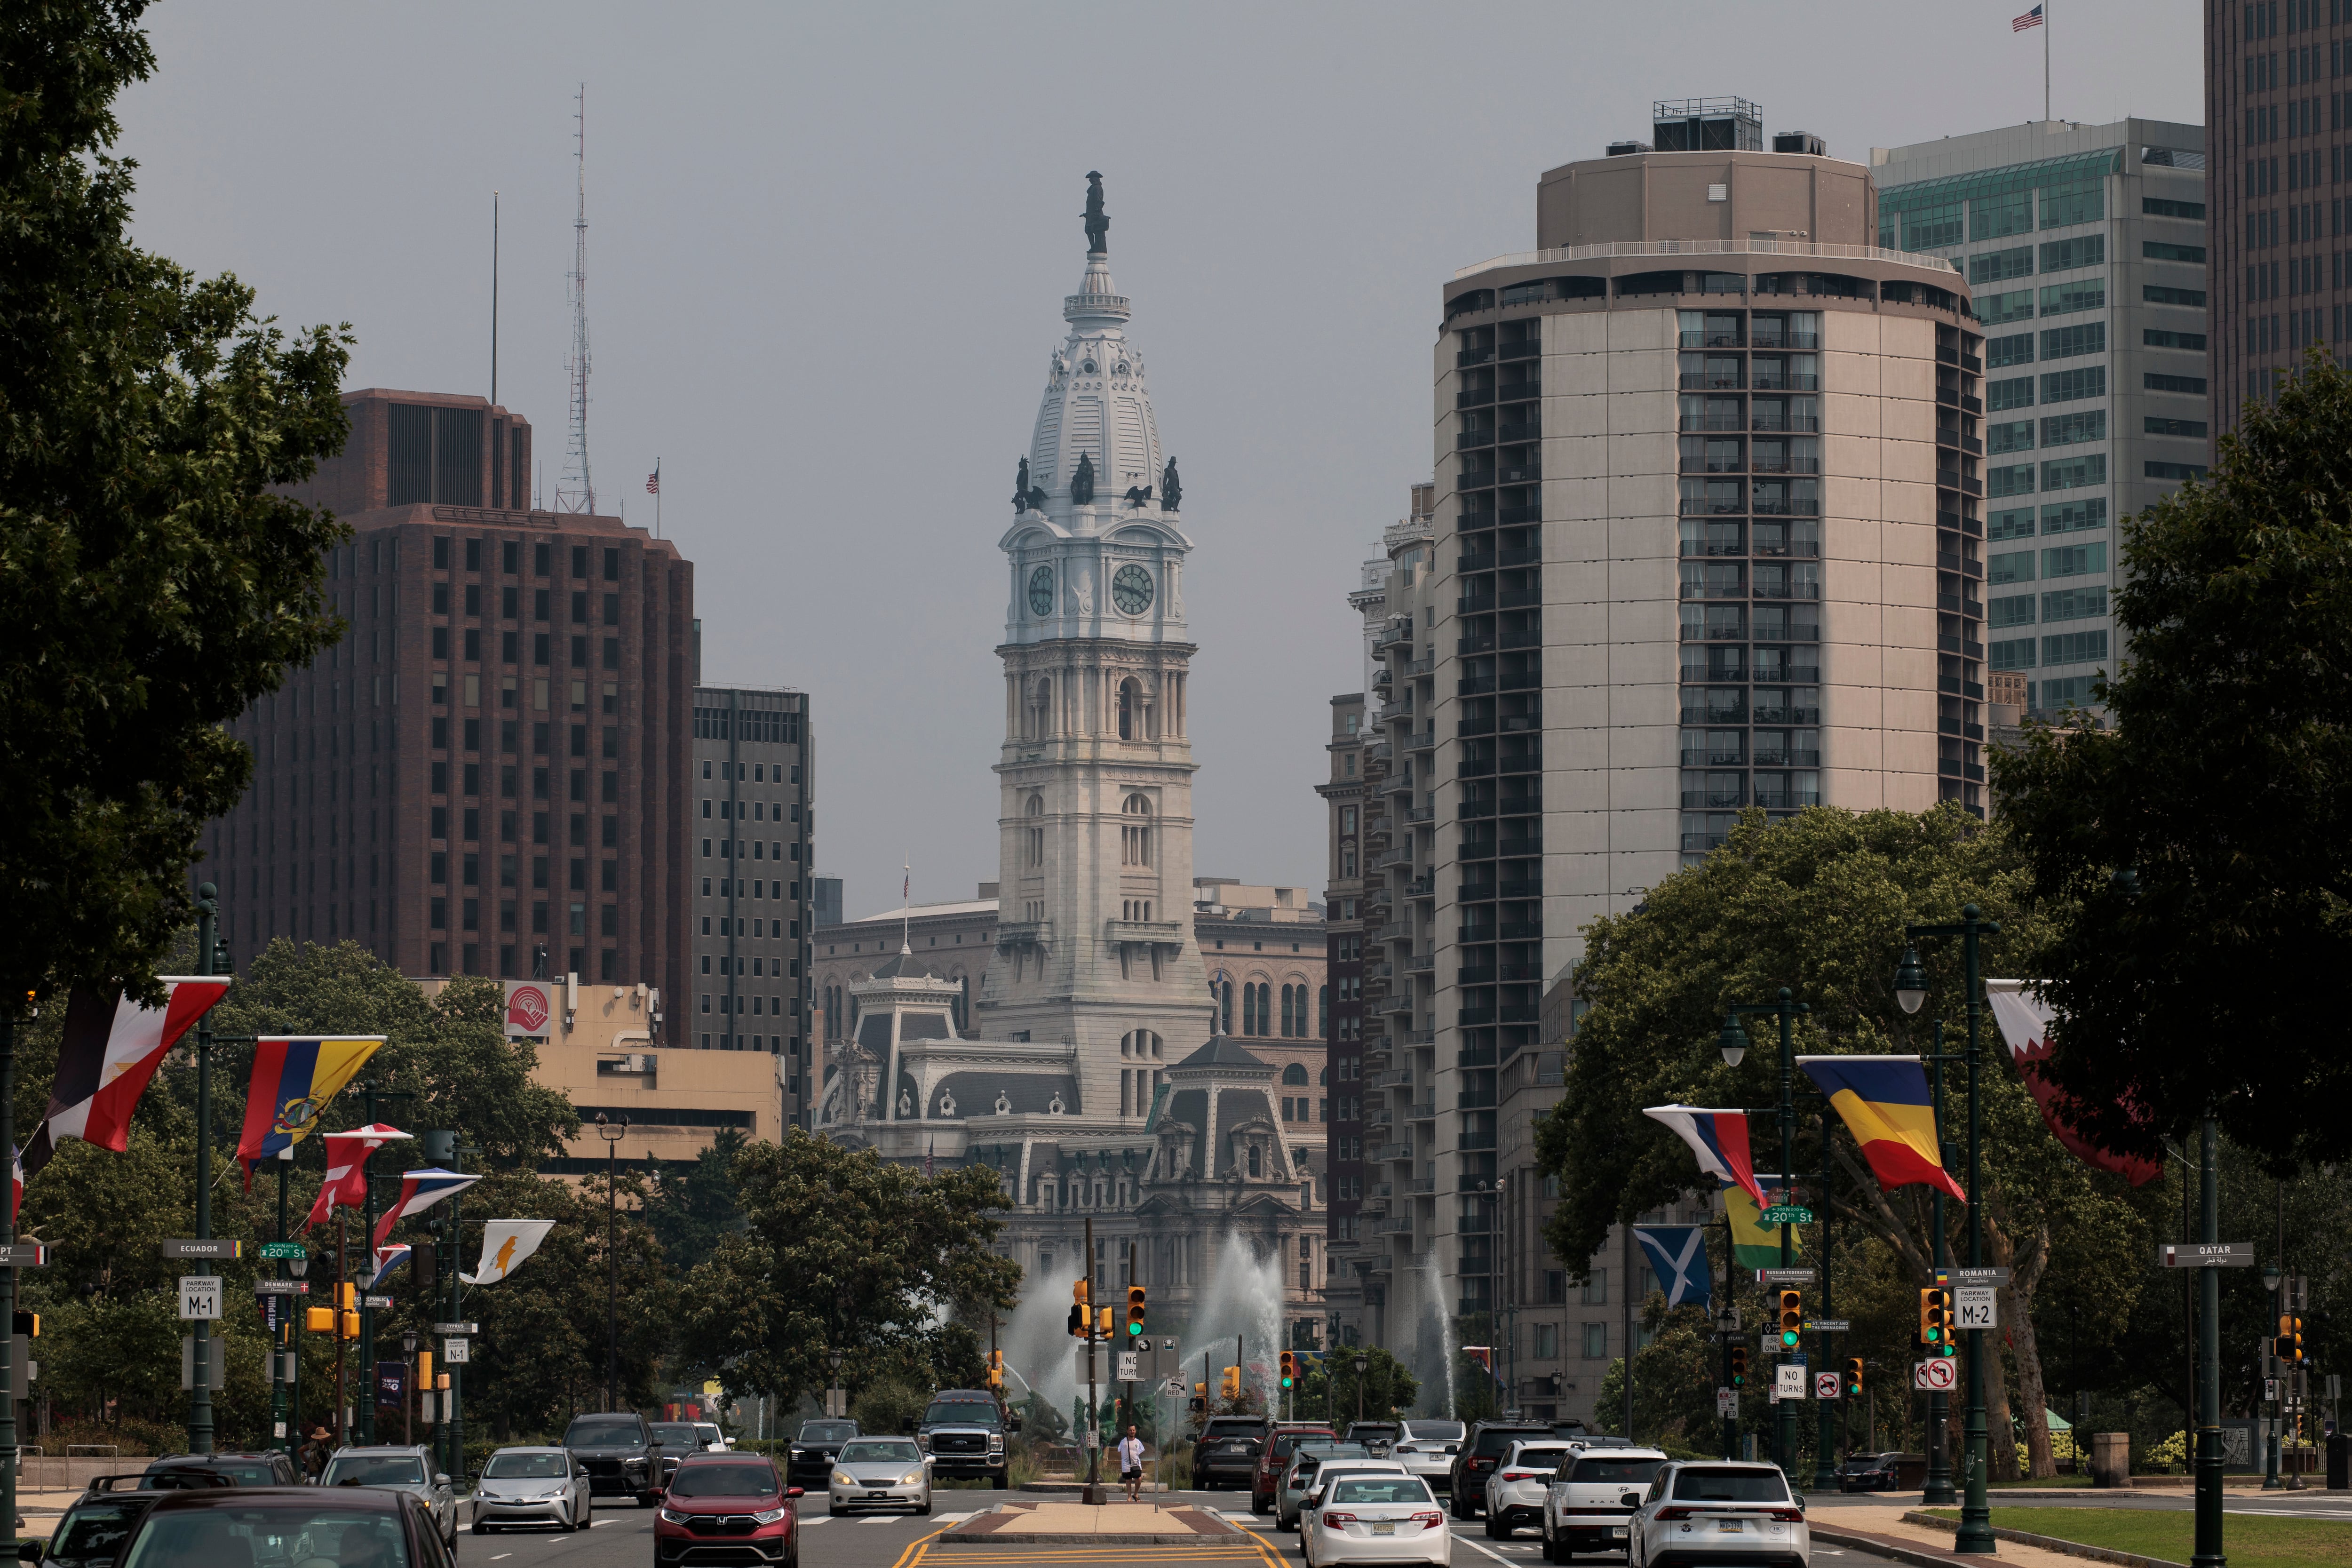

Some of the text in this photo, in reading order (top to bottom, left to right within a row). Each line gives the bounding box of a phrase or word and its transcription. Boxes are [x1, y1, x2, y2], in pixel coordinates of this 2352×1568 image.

[1772, 1212, 1812, 1222] 20th St
[269, 1248, 305, 1258] 20th St
[2199, 1246, 2231, 1255] QATAR
[189, 1296, 212, 1315] M-1
[1963, 1305, 1989, 1324] M-2
[450, 1349, 463, 1360] N-1
[1785, 1371, 1797, 1380] NO
